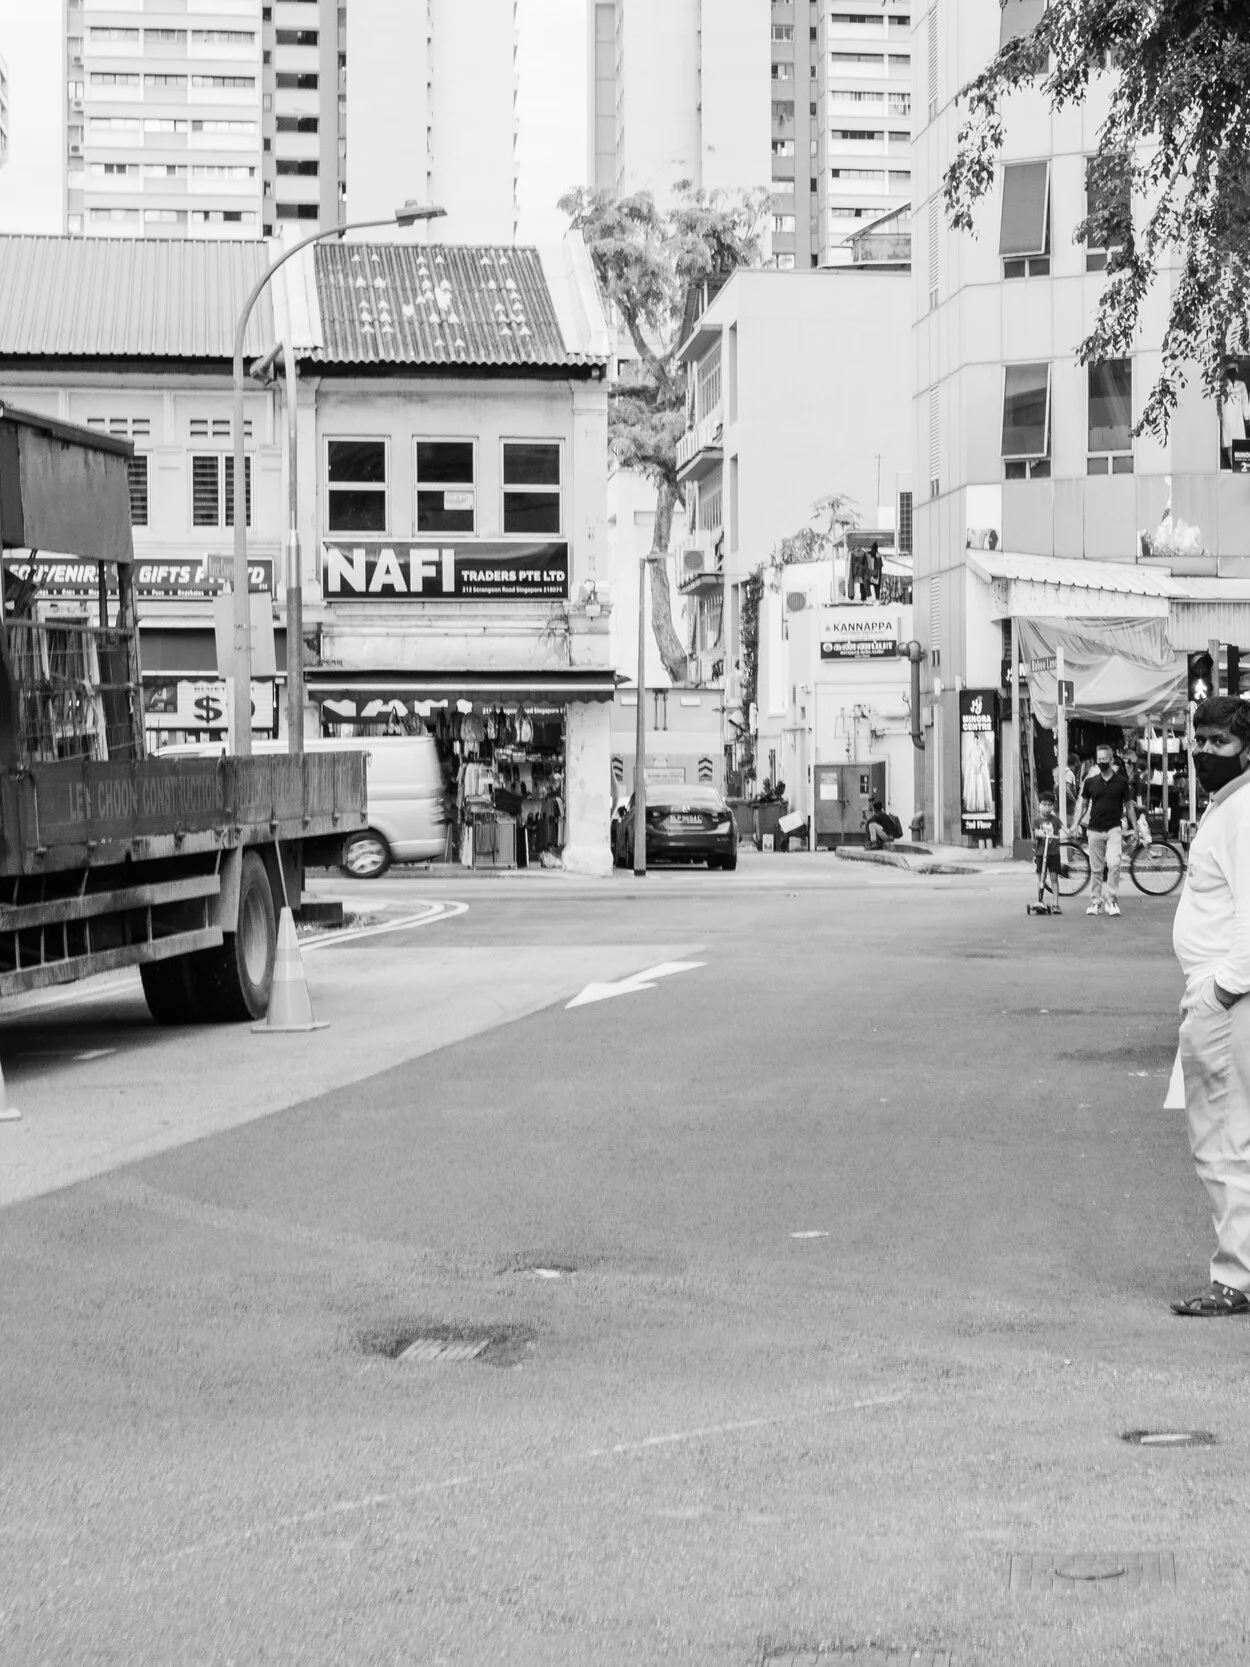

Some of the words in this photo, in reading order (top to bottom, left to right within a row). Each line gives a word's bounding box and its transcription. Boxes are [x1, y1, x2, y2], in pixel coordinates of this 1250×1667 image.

[139, 565, 191, 583] GIFTS
[327, 548, 455, 592] NAFI
[461, 570, 517, 581] TRADERS
[518, 570, 541, 581] PTE
[543, 570, 566, 581] LTD
[833, 621, 893, 632] KANNAPPA
[962, 714, 992, 723] MINORA
[962, 723, 992, 731] CENTRE
